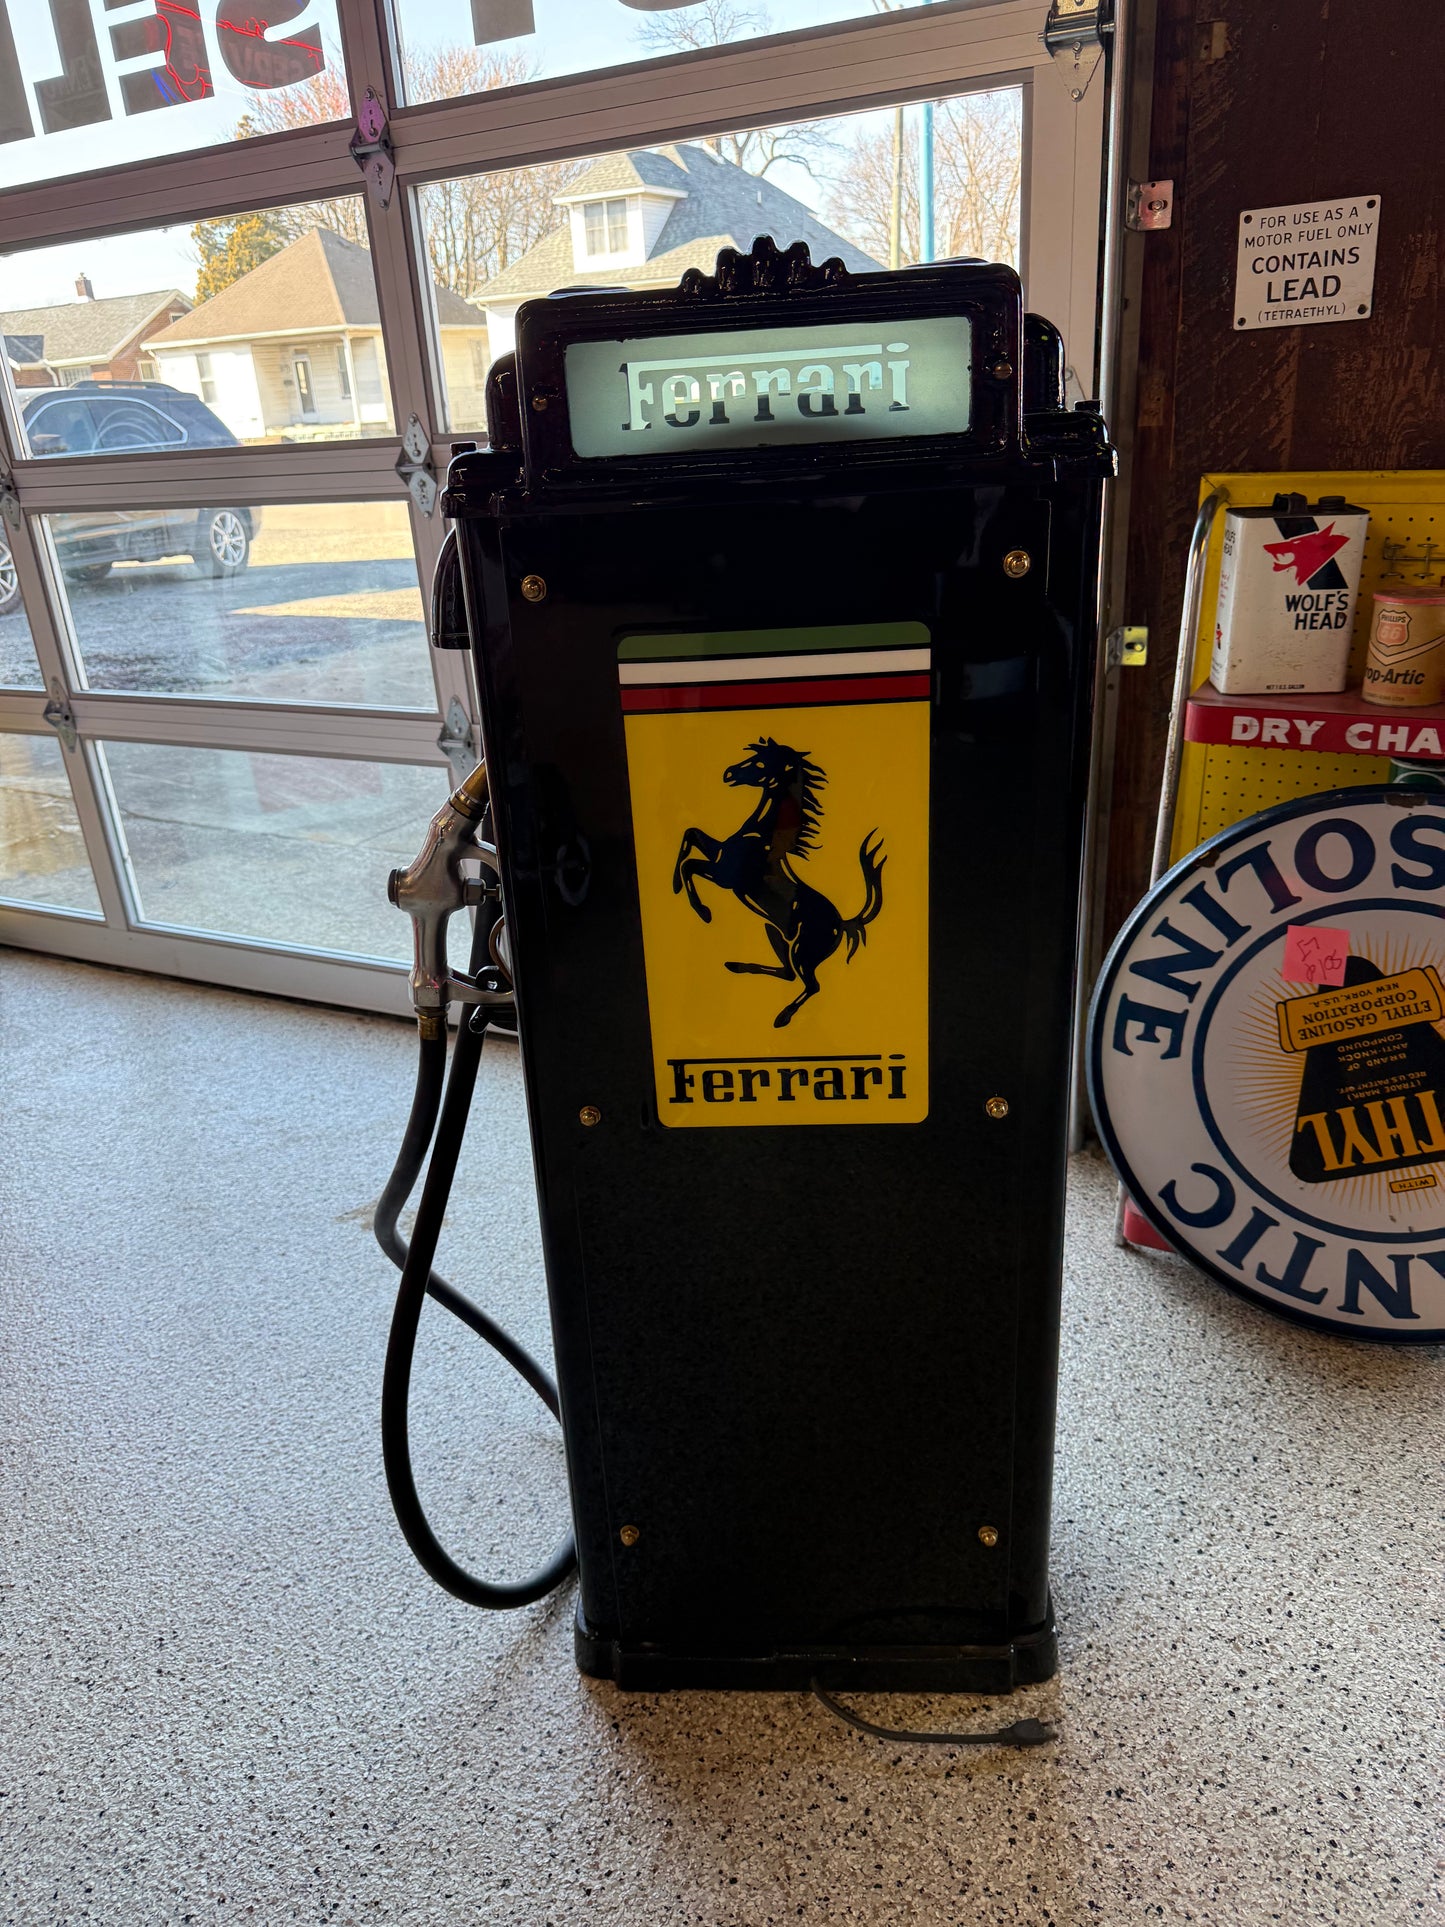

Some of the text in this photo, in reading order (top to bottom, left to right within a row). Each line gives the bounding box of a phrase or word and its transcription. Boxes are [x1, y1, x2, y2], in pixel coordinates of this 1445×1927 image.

[1260, 206, 1359, 229] FOR USE AS A
[1244, 222, 1374, 248] MOTOR FUEL ONLY
[1251, 246, 1360, 275] CONTAINS
[1266, 274, 1342, 304] LEAD
[1258, 302, 1346, 324] (TETRAETHYL)
[618, 342, 911, 432] Ferrari
[1284, 590, 1350, 612] WOLF'S
[1294, 612, 1348, 631] HEAD
[1380, 627, 1403, 639] 66
[1365, 667, 1425, 685] op-Artic
[1231, 715, 1445, 755] DRY CHA
[1375, 982, 1399, 994] NEW
[1302, 989, 1417, 1024] CORPORATION
[1297, 1000, 1433, 1041] ETHYL GASOLINE
[1337, 1033, 1403, 1053] COMPOUND
[1337, 1042, 1408, 1062] ANTI-KNOCK
[1347, 1053, 1407, 1072] BRAND OF
[667, 1053, 907, 1104] Ferrari
[1398, 1180, 1430, 1190] WITH
